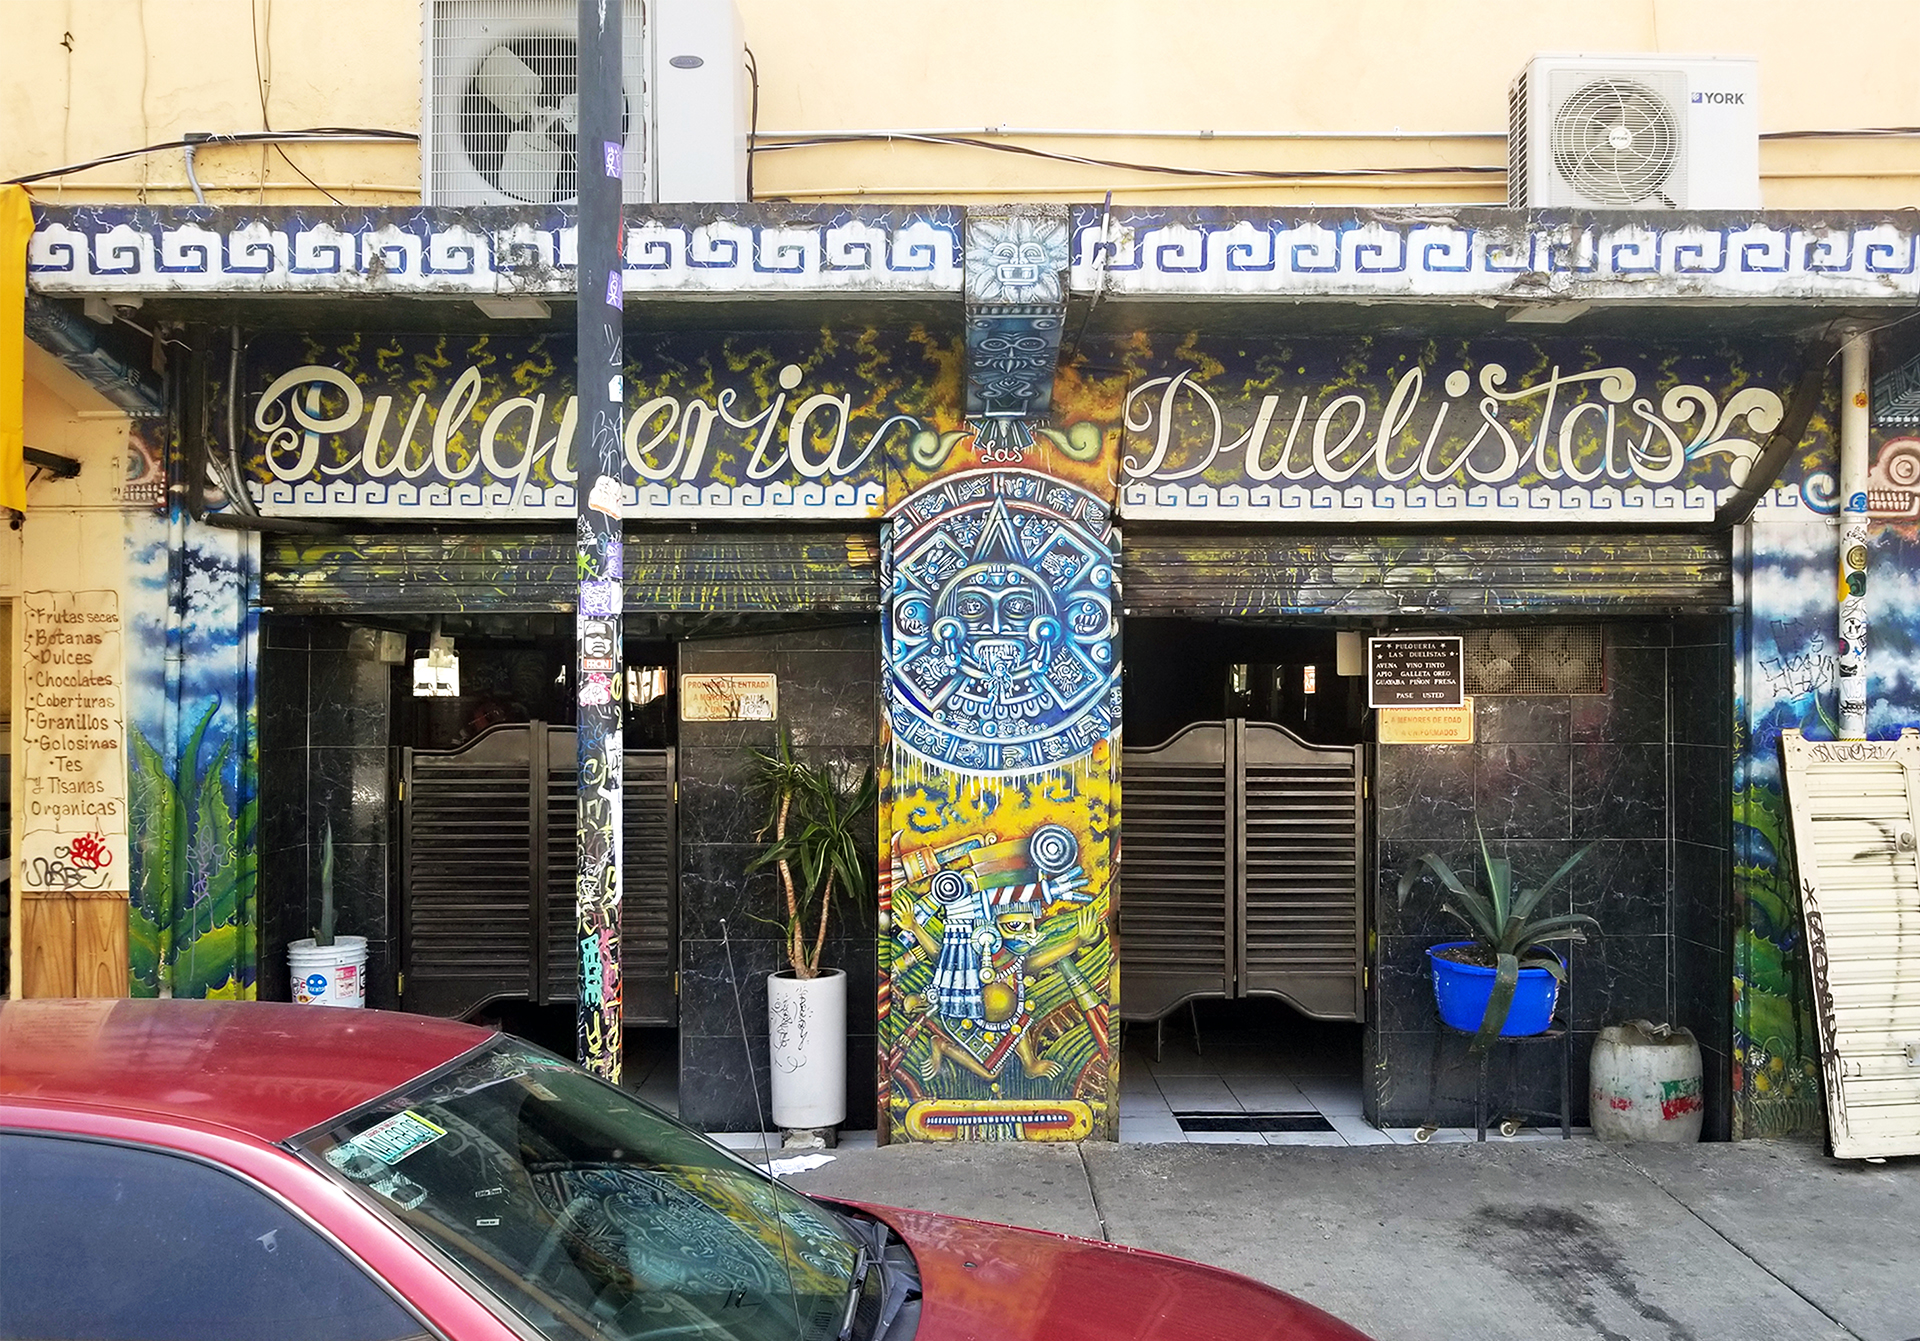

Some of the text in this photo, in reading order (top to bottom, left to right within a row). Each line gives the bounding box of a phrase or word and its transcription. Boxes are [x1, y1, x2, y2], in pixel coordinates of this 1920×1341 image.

[1704, 92, 1745, 105] YORK
[1121, 363, 1784, 488] Duelistas
[981, 440, 1023, 463] Las
[37, 608, 85, 624] Frutas
[35, 628, 103, 646] Botanas
[40, 649, 93, 665] Dulces
[35, 669, 113, 687] Chocolates
[36, 693, 115, 709] Coberturas
[36, 712, 109, 730] Granillos
[40, 734, 118, 751] Golosinas
[55, 756, 83, 772] Tes
[32, 776, 105, 794] y Tisanas
[31, 800, 117, 821] Organicas
